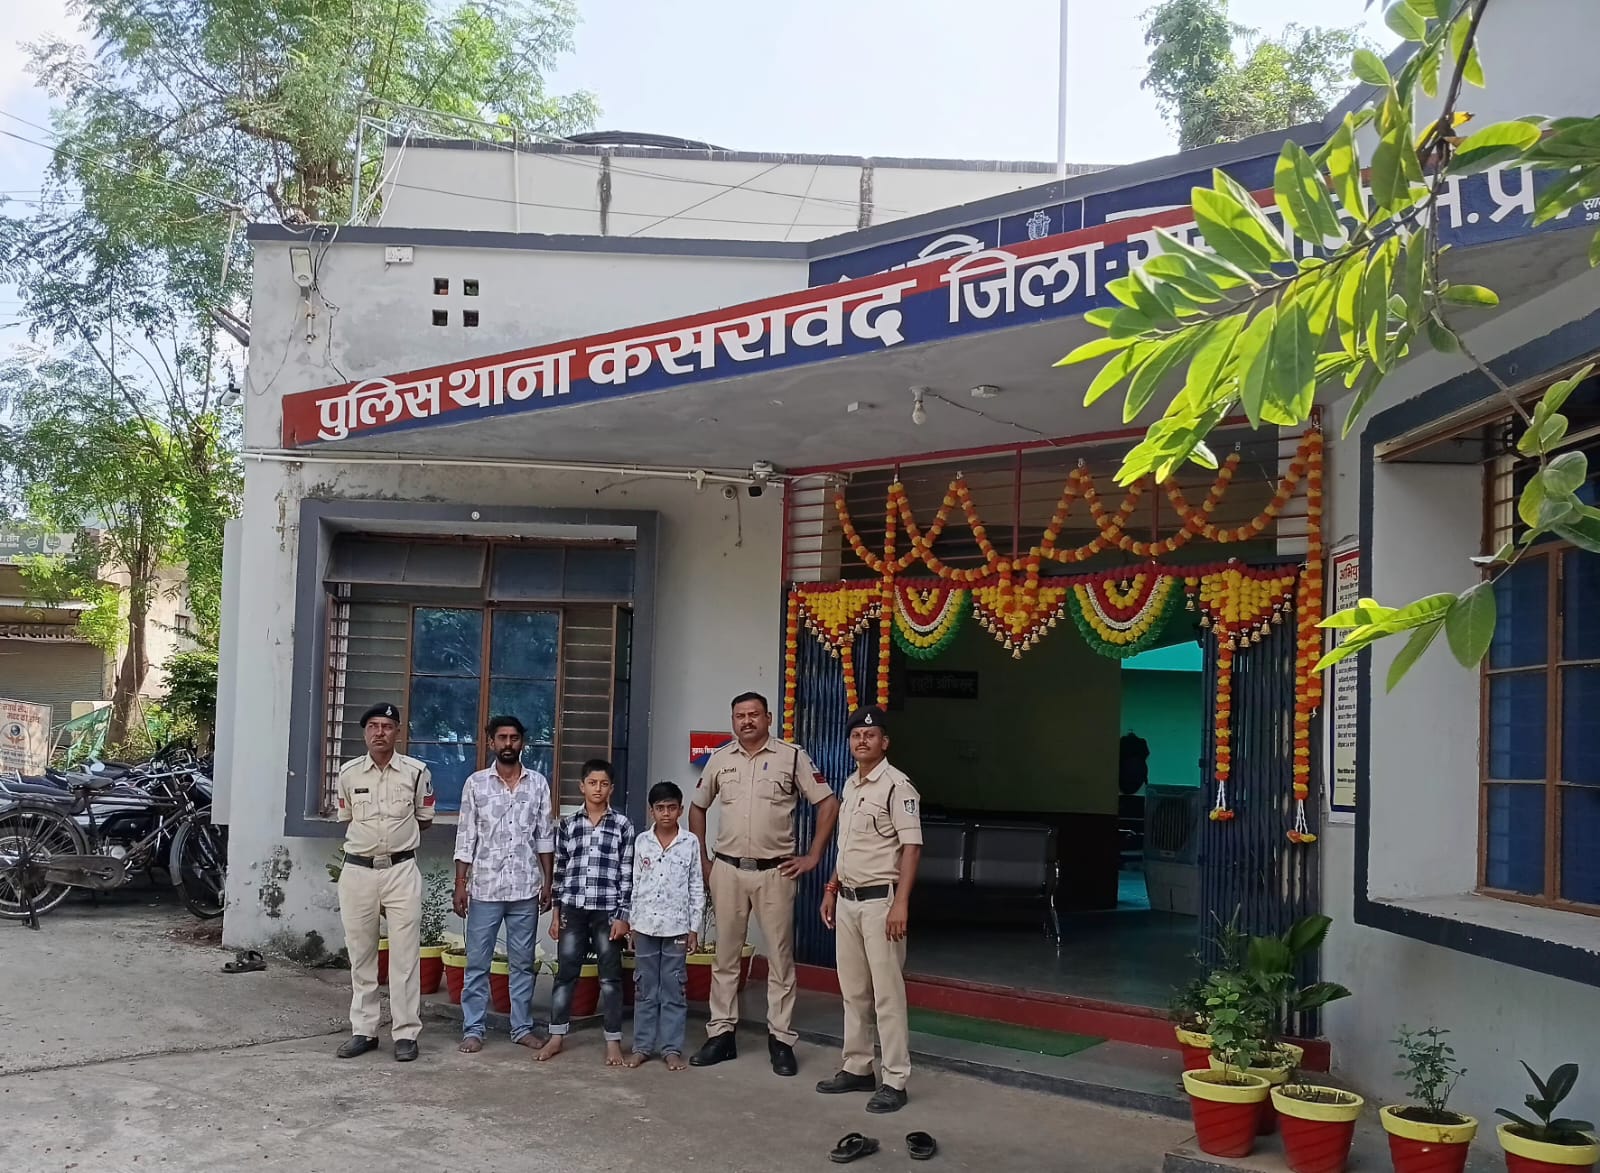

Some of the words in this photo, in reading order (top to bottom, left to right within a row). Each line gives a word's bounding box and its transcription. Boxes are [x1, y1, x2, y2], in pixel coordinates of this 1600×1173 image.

[315, 376, 443, 441] पुलिस
[448, 349, 577, 408] थाना
[583, 278, 918, 387] कसरावद
